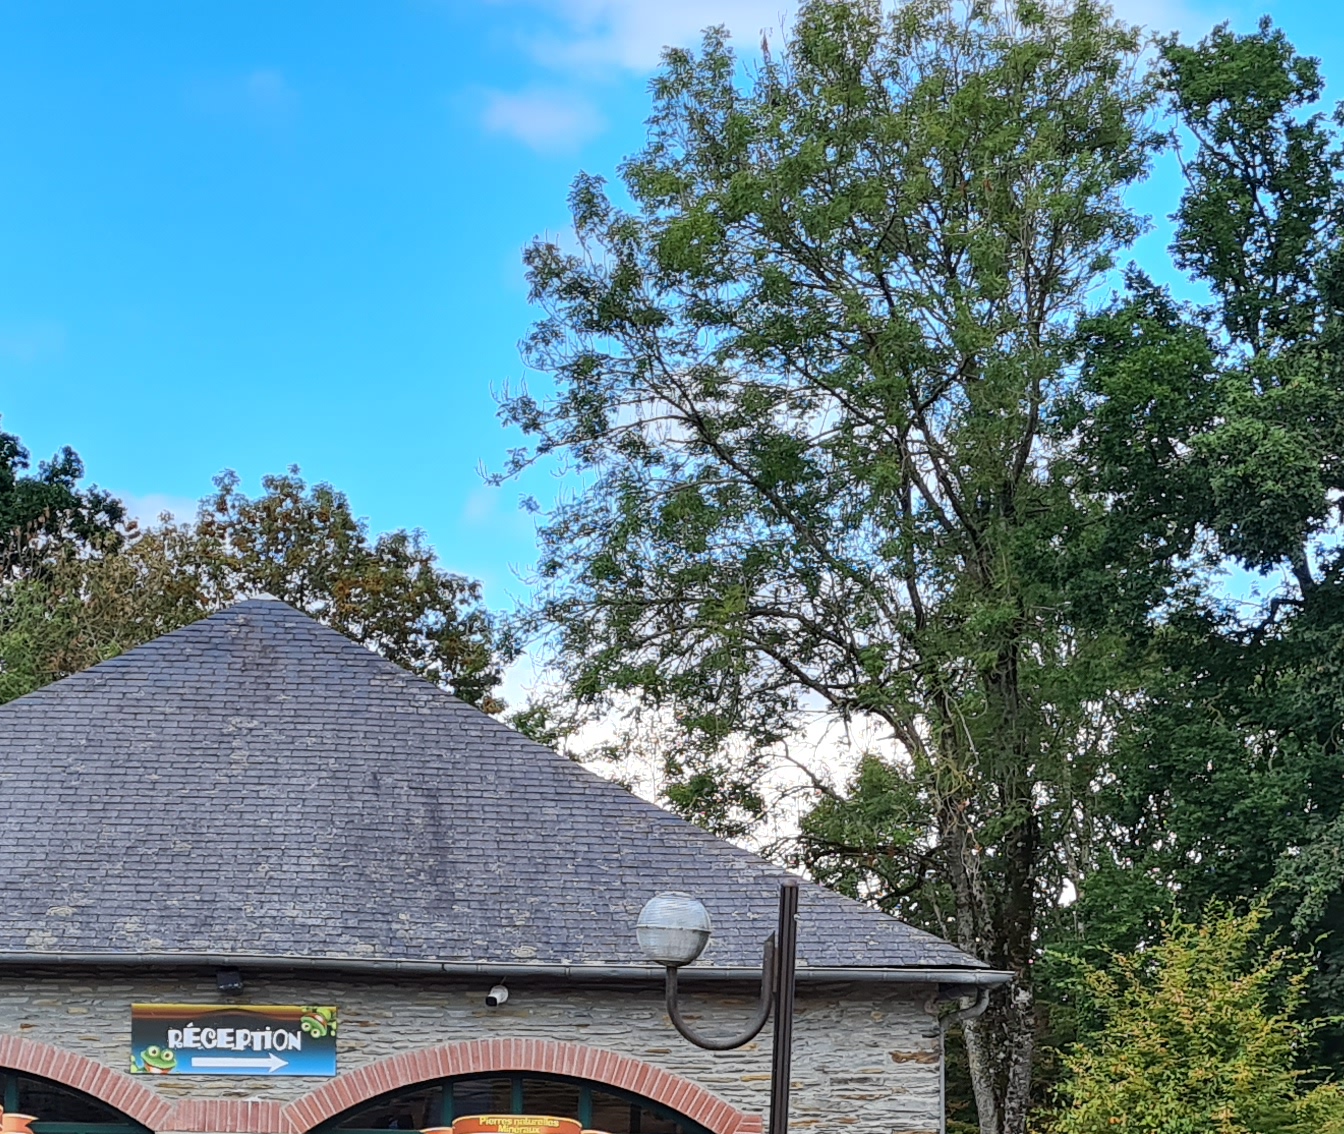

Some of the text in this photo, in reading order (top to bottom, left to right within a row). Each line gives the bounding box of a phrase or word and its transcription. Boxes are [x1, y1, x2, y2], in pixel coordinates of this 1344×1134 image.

[167, 1021, 302, 1051] RÉCEPTION
[479, 1117, 559, 1127] Pierres naturelles
